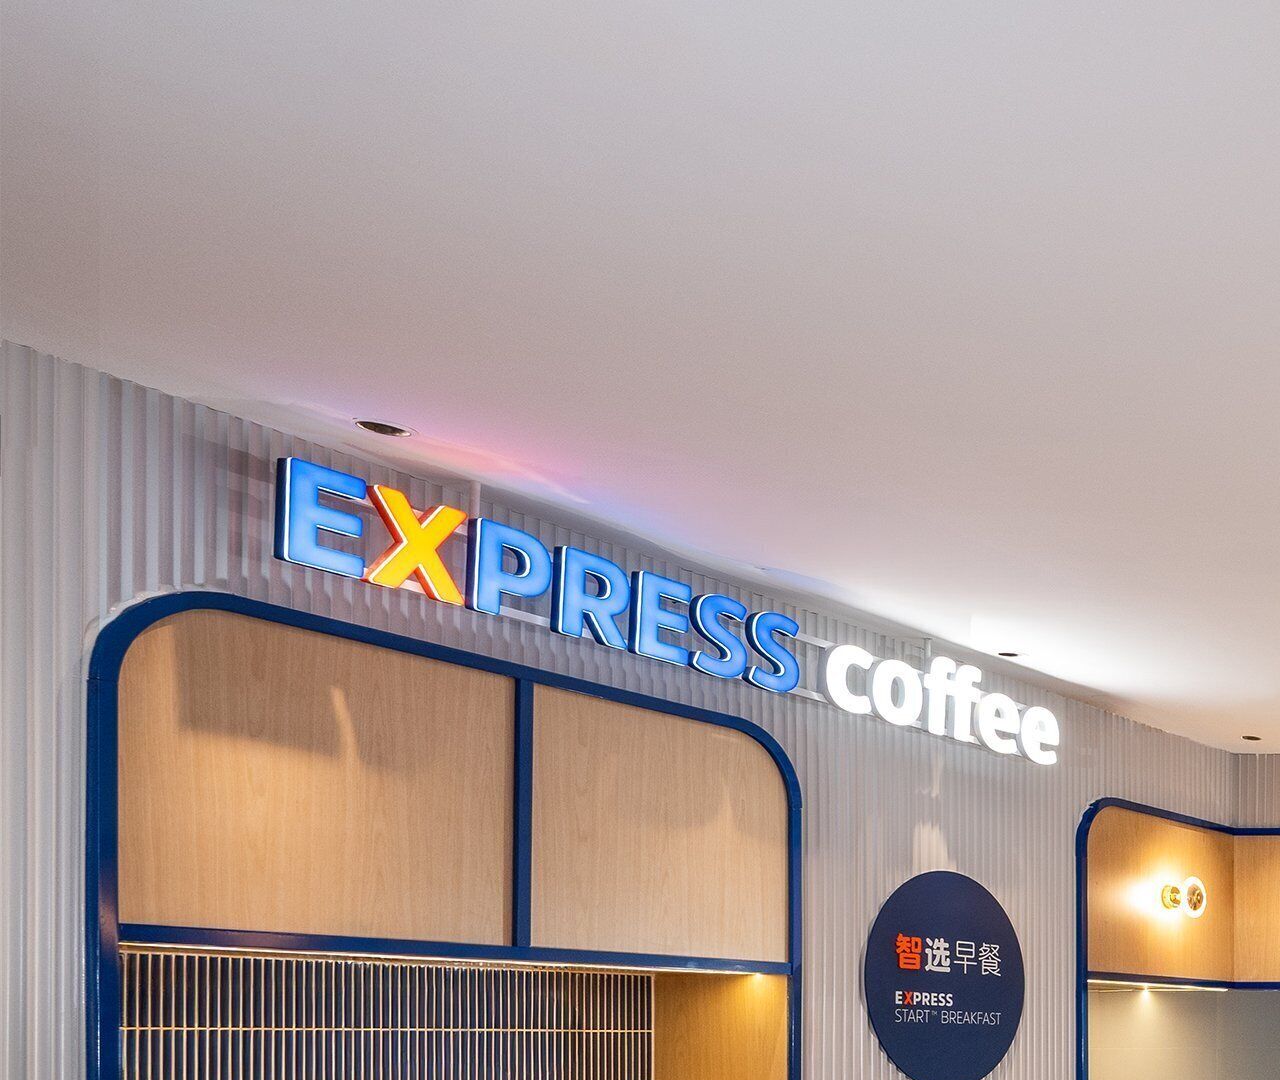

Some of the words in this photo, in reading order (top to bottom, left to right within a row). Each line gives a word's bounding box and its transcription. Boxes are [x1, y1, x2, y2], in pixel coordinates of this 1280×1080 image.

[275, 456, 801, 694] EXPRESS
[822, 643, 1061, 767] coffee
[895, 933, 1002, 977] 智选早餐
[895, 990, 953, 1007] EXPRESS
[941, 1010, 1002, 1026] BREAKFAST
